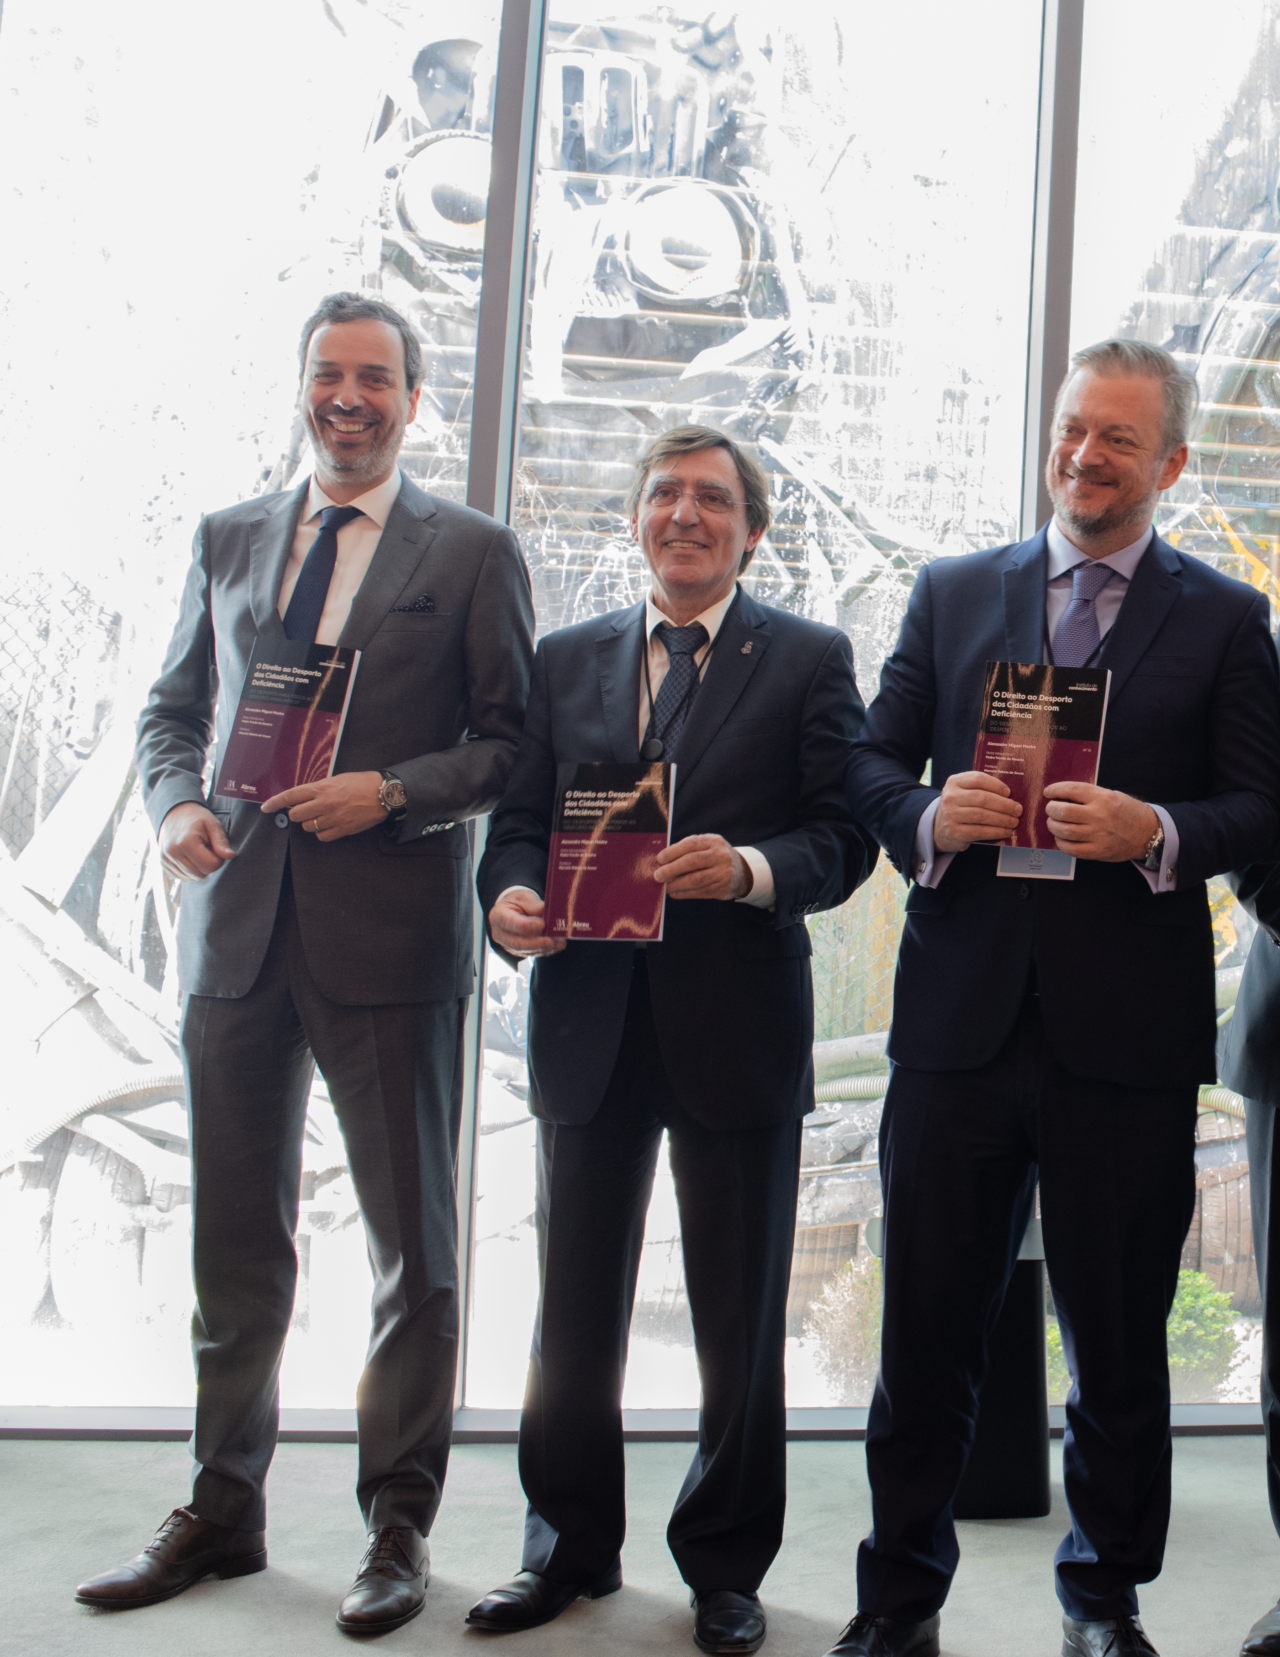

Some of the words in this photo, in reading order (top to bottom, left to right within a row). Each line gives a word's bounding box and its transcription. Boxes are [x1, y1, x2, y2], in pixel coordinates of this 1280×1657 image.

[265, 673, 295, 681] Cidadãos
[293, 668, 322, 677] Desporto
[251, 679, 286, 689] Deficiência
[1001, 691, 1026, 700] Direito
[1039, 694, 1073, 703] Desporto
[1007, 701, 1043, 710] Cidadãos
[991, 710, 1032, 719] Deficiência
